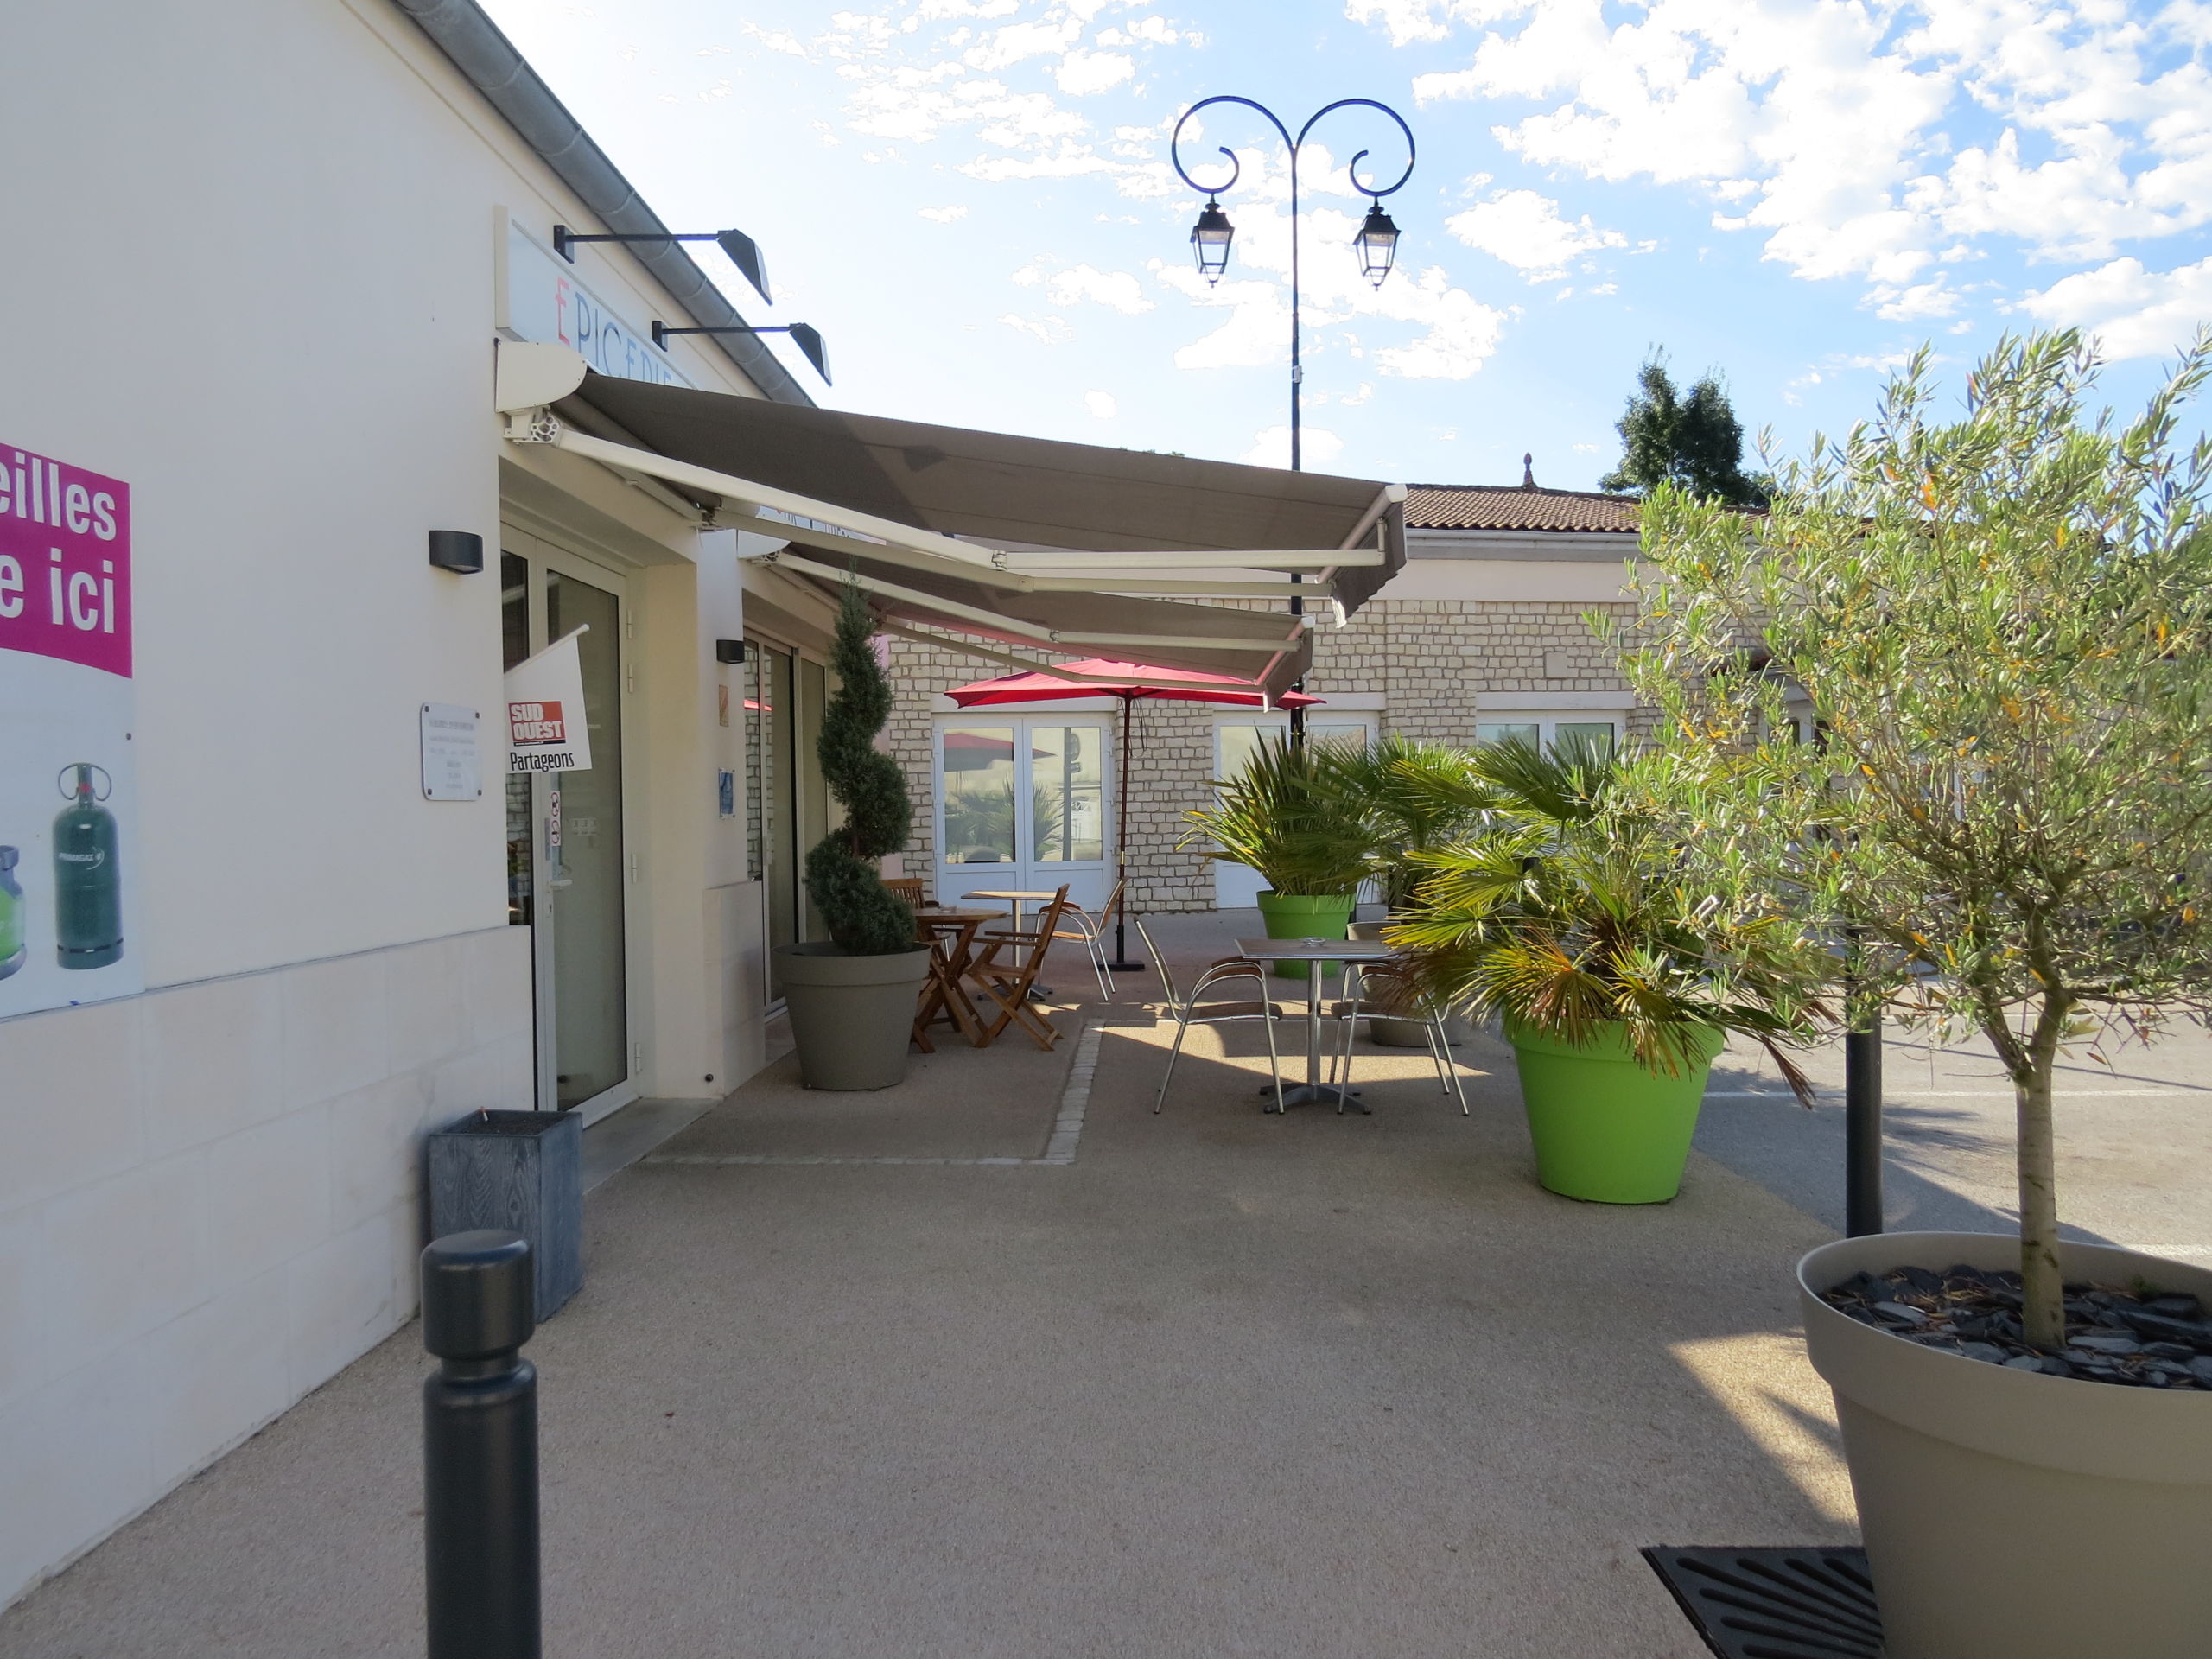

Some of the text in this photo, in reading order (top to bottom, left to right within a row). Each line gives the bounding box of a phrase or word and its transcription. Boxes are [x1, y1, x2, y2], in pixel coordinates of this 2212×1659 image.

[50, 547, 115, 634] ici
[510, 703, 543, 721] SUD
[513, 721, 563, 740] OUEST
[510, 752, 575, 772] Partageons
